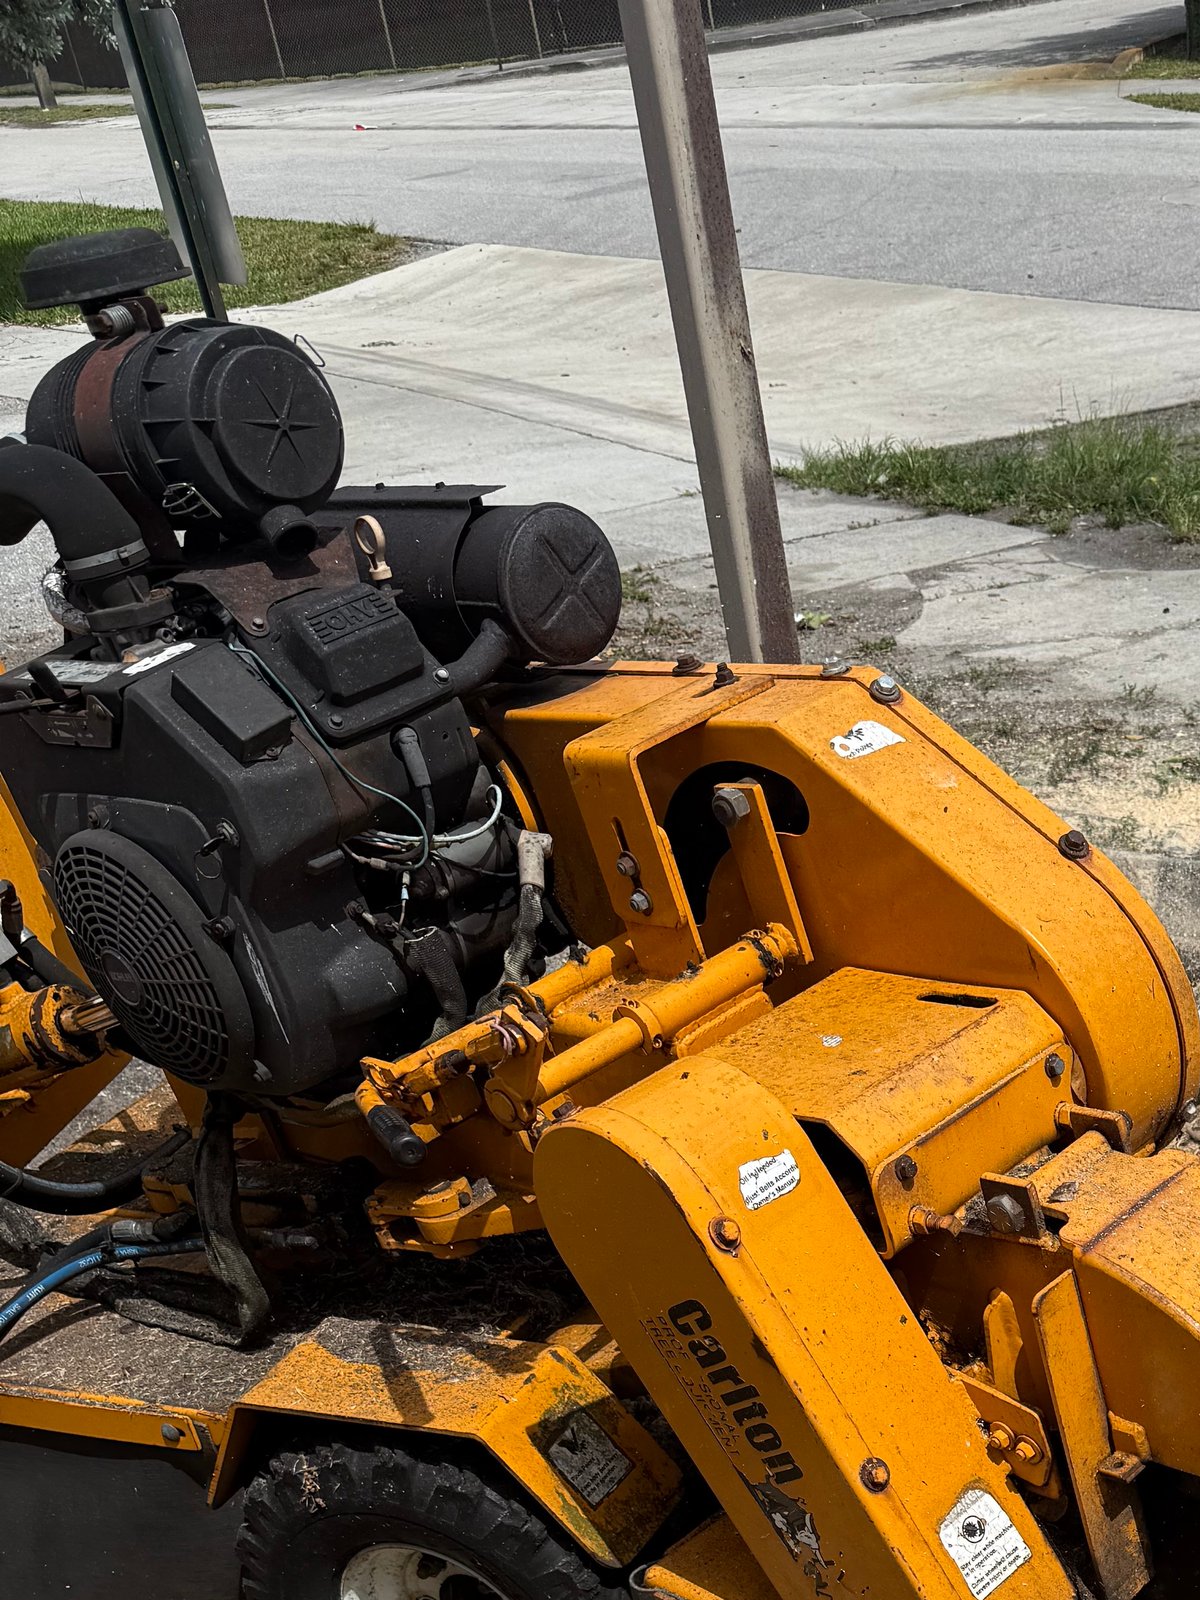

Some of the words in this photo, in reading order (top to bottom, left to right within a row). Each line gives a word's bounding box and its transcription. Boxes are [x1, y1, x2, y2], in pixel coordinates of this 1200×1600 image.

[742, 1190, 760, 1205] djust
[759, 1180, 775, 1193] Belts
[773, 1175, 797, 1193] Manual
[645, 1315, 677, 1361] TREE
[656, 1315, 740, 1444] PROFSIONAL
[667, 1298, 804, 1485] Carlton
[959, 1559, 972, 1571] Stay
[970, 1549, 983, 1562] clear
[981, 1538, 995, 1551] while
[992, 1522, 1013, 1541] machine
[970, 1574, 985, 1589] Cutter
[984, 1563, 998, 1577] wheel
[1004, 1545, 1018, 1558] cause
[975, 1580, 990, 1595] severe
[988, 1569, 1003, 1583] injury
